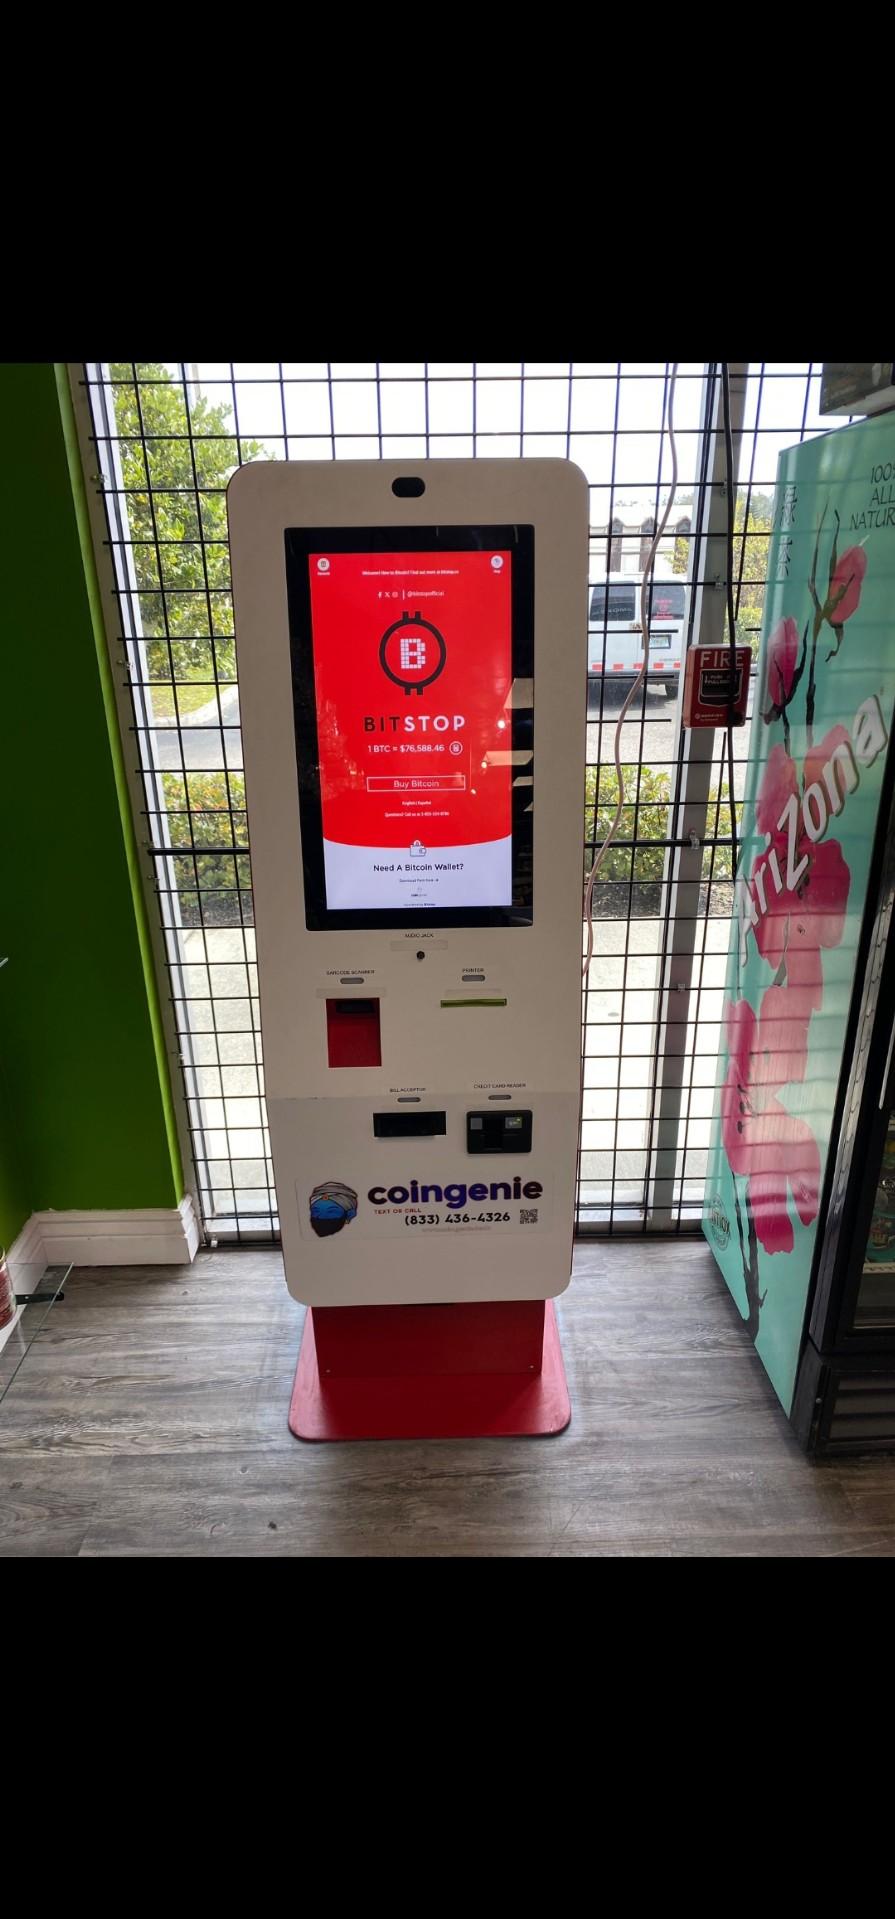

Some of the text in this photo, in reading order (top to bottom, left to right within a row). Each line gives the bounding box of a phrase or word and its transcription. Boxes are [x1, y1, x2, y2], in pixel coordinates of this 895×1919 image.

[869, 485, 895, 507] ALL
[700, 650, 745, 668] FIRE
[364, 715, 465, 732] BITSTOP
[373, 745, 391, 753] BTC
[400, 744, 445, 753] $76,588.46
[393, 779, 440, 789] Buy Bitcoin
[373, 864, 394, 872] Need
[405, 863, 433, 871] Bitcoin
[434, 863, 464, 871] Wallet?
[367, 1176, 544, 1209] coingenie
[404, 1212, 511, 1227] (833) 436-4326
